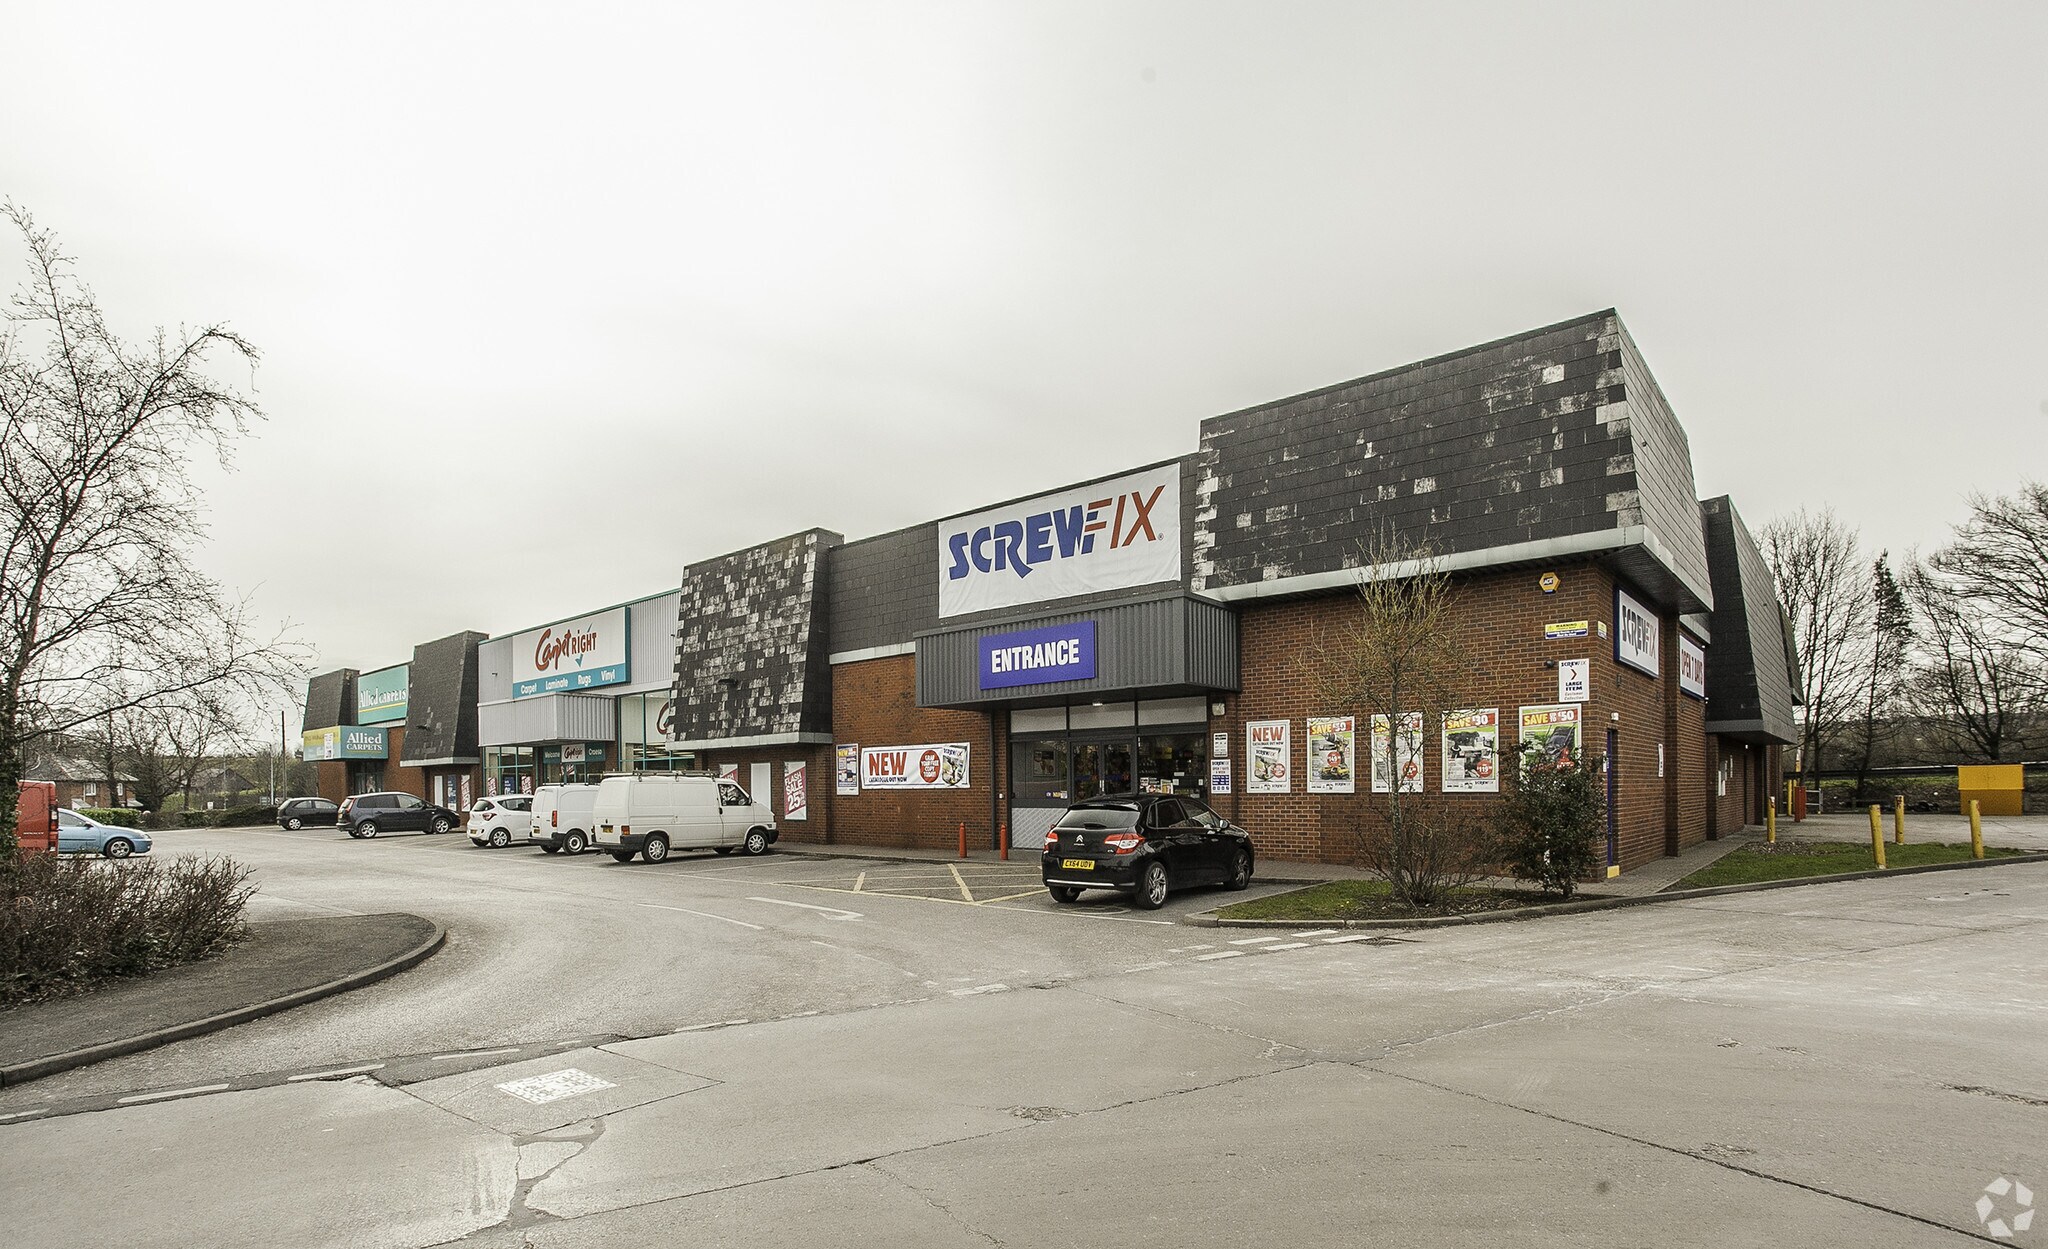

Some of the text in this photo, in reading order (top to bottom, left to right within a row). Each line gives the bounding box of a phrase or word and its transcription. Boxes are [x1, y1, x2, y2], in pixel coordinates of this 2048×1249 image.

[948, 484, 1166, 580] SCREWFIX
[1622, 604, 1657, 660] SCREWFIX
[991, 638, 1080, 674] ENTRANCE
[1681, 648, 1691, 679] OPEN
[521, 669, 616, 695] Carpet Laminate Rugs Vinyl
[359, 687, 379, 709] Allied
[1447, 717, 1472, 729] SAVE
[1523, 714, 1548, 726] SAVE
[1252, 726, 1284, 742] NEW
[1311, 723, 1332, 735] SAVE
[347, 732, 382, 744] Allied
[346, 743, 382, 751] CARPETS
[868, 752, 907, 776] NEW
[785, 771, 802, 786] FLASH
[786, 780, 803, 795] SALE
